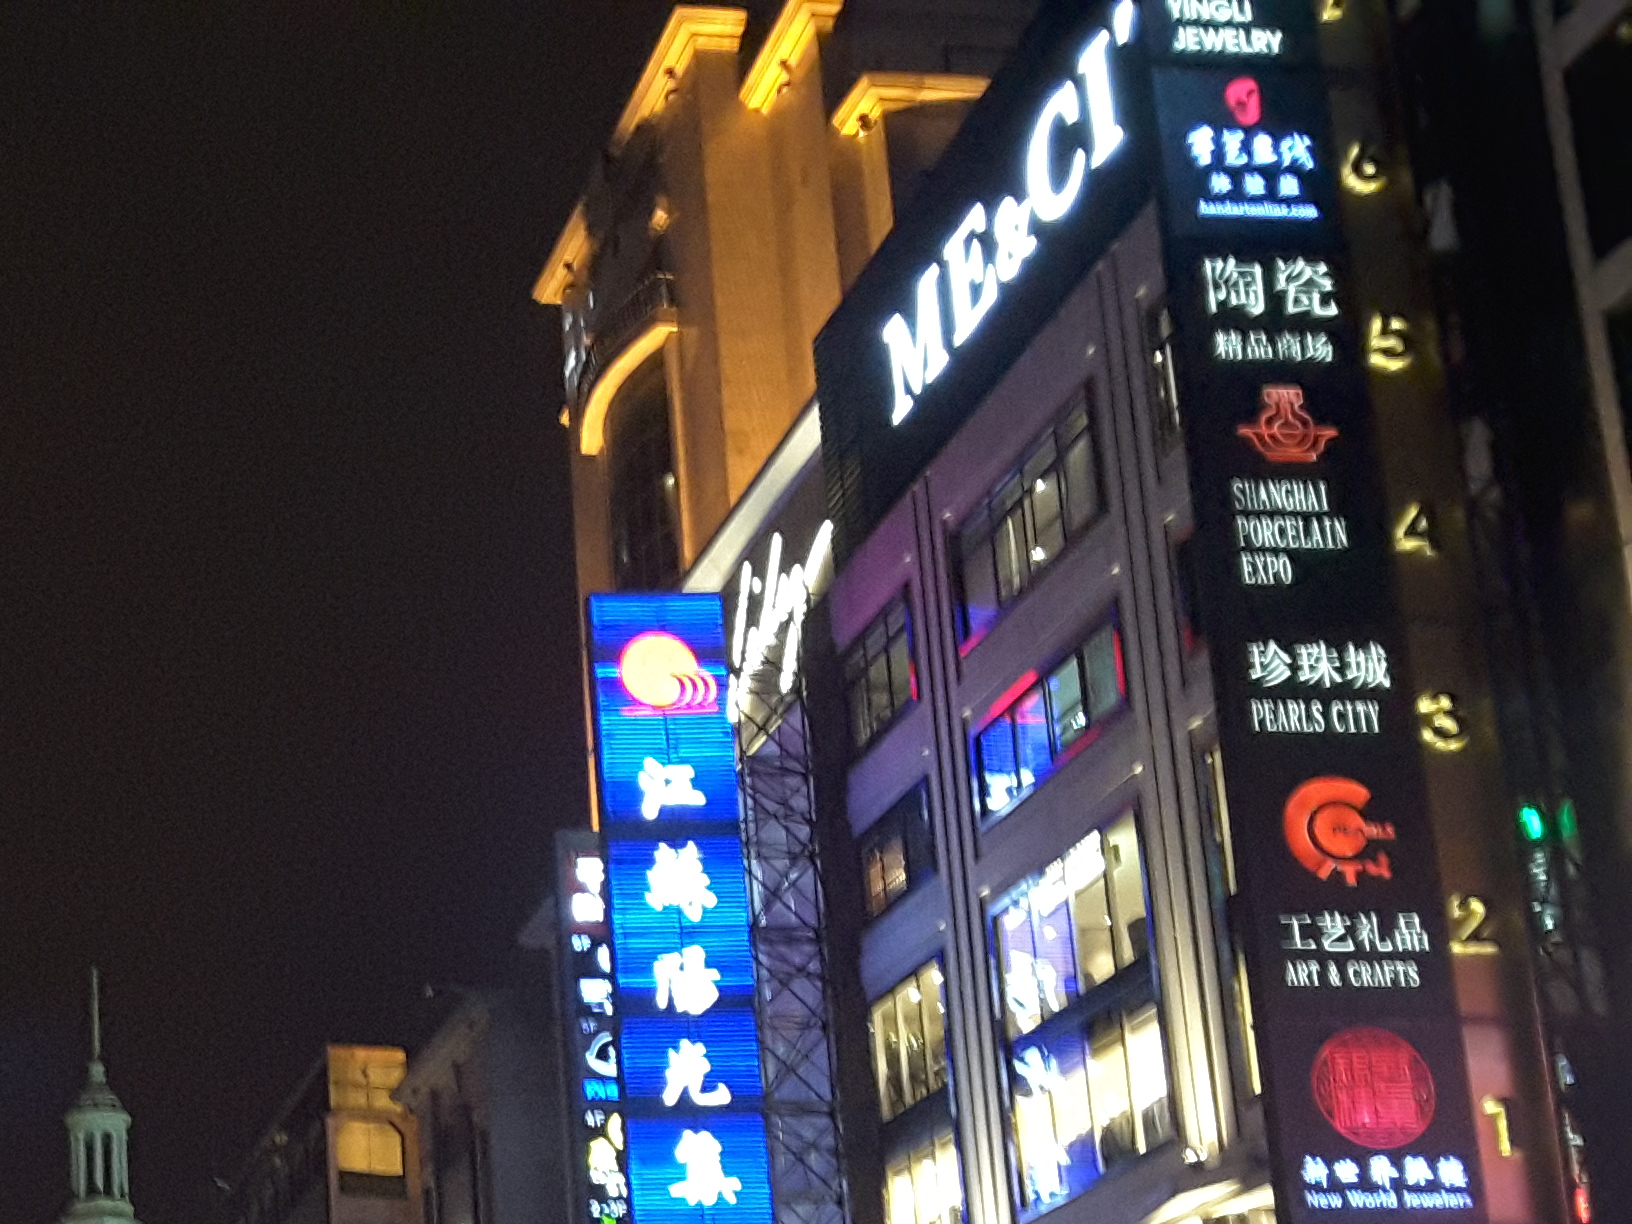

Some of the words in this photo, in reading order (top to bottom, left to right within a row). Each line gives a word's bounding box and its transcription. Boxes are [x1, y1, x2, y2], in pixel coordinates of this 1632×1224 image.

[1172, 26, 1283, 55] JEWELRY
[882, 0, 1135, 428] ME&CI
[1203, 254, 1339, 318] 陶瓷
[1215, 329, 1334, 362] 精品商场
[1368, 312, 1412, 372] 5
[1232, 476, 1330, 512] SHANGHAI
[1236, 514, 1349, 549] PORCELAIN
[1392, 502, 1436, 557] 4
[1240, 552, 1294, 585] EXPO
[1246, 639, 1392, 688] 珍珠城
[1251, 698, 1325, 733] PEARLS
[1331, 698, 1381, 734] CITY
[1415, 692, 1468, 751] 3
[1279, 910, 1430, 952] 工艺礼品
[1447, 893, 1501, 955] 2
[1285, 960, 1321, 987] ART
[1327, 960, 1343, 987] &
[1347, 959, 1421, 987] CRAFTS
[1483, 1096, 1512, 1157] 1
[1304, 1189, 1343, 1208] New
[1346, 1188, 1399, 1208] World
